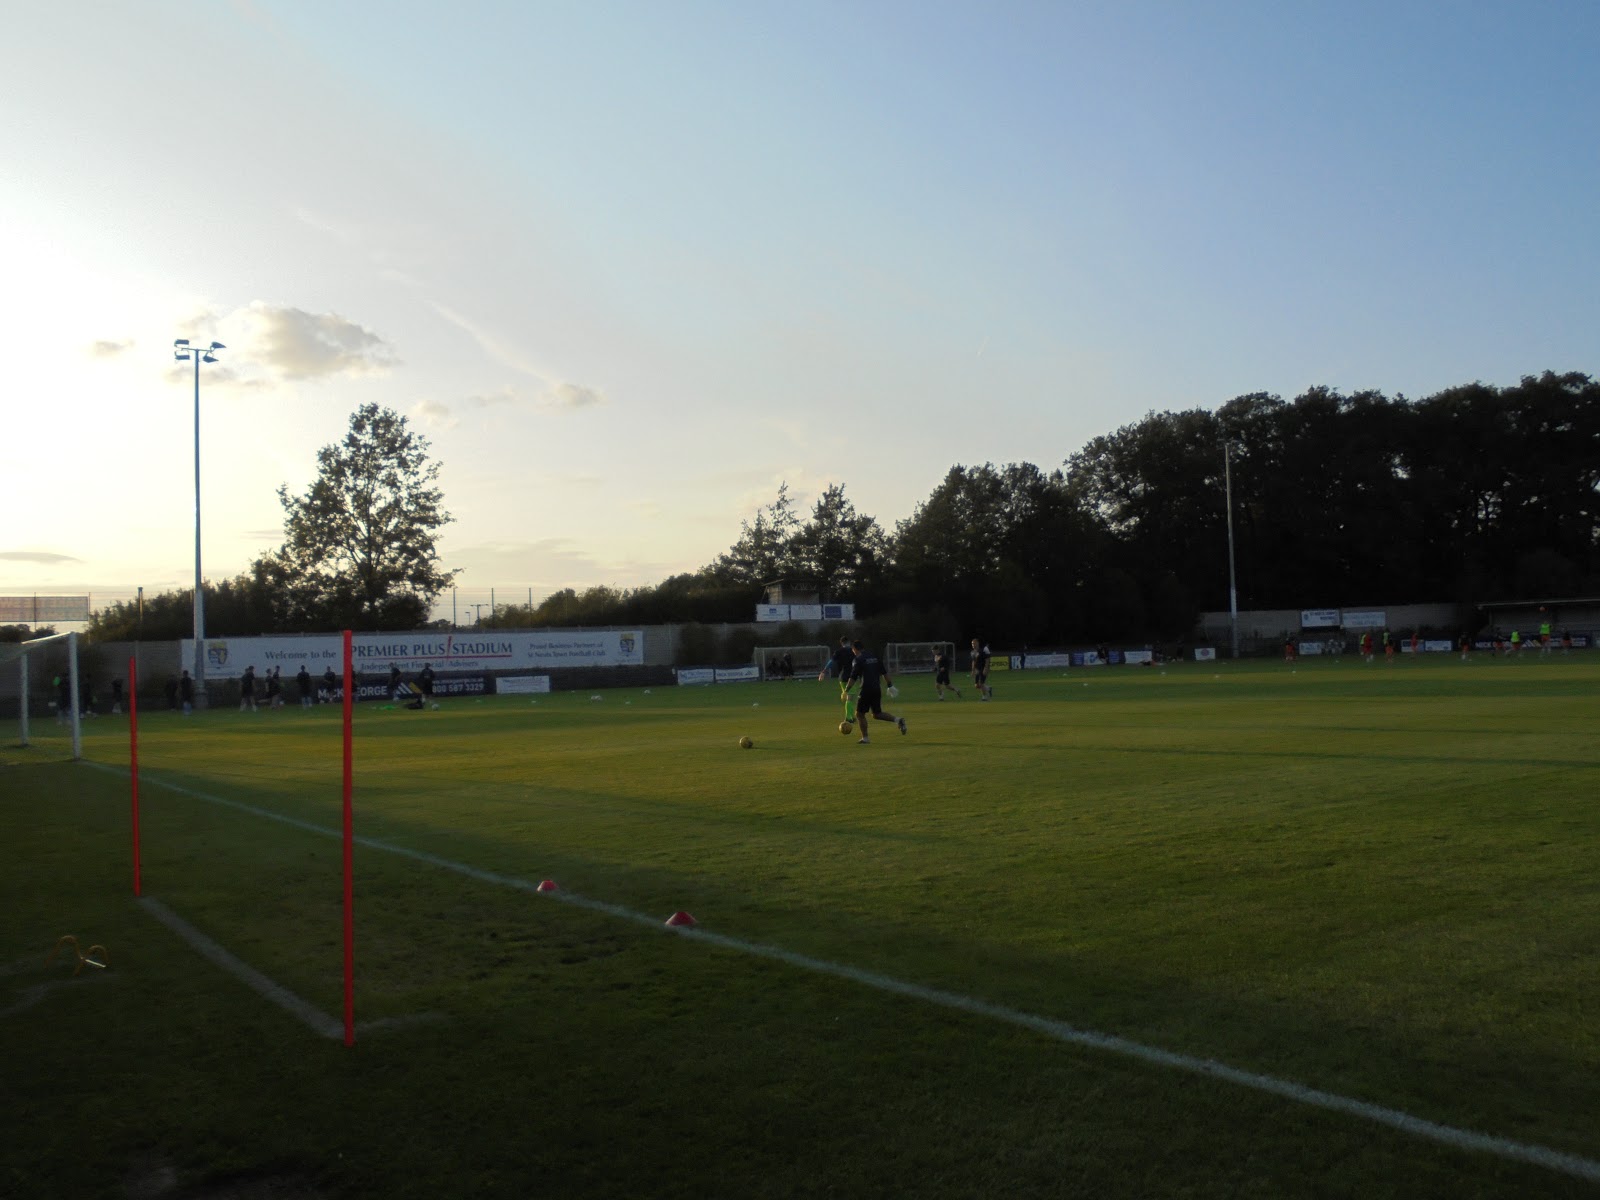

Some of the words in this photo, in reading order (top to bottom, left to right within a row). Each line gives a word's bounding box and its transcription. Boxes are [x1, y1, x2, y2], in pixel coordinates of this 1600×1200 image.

[264, 650, 308, 660] Welcome
[311, 650, 320, 659] to
[322, 649, 337, 659] the
[352, 644, 408, 657] PREMIER
[413, 643, 445, 656] PLUS
[453, 642, 512, 655] STADIUM
[361, 661, 409, 672] Indepeent
[411, 660, 443, 669] Fincial
[317, 688, 344, 698] MCK
[355, 685, 388, 697] EORGE
[432, 685, 447, 693] 800
